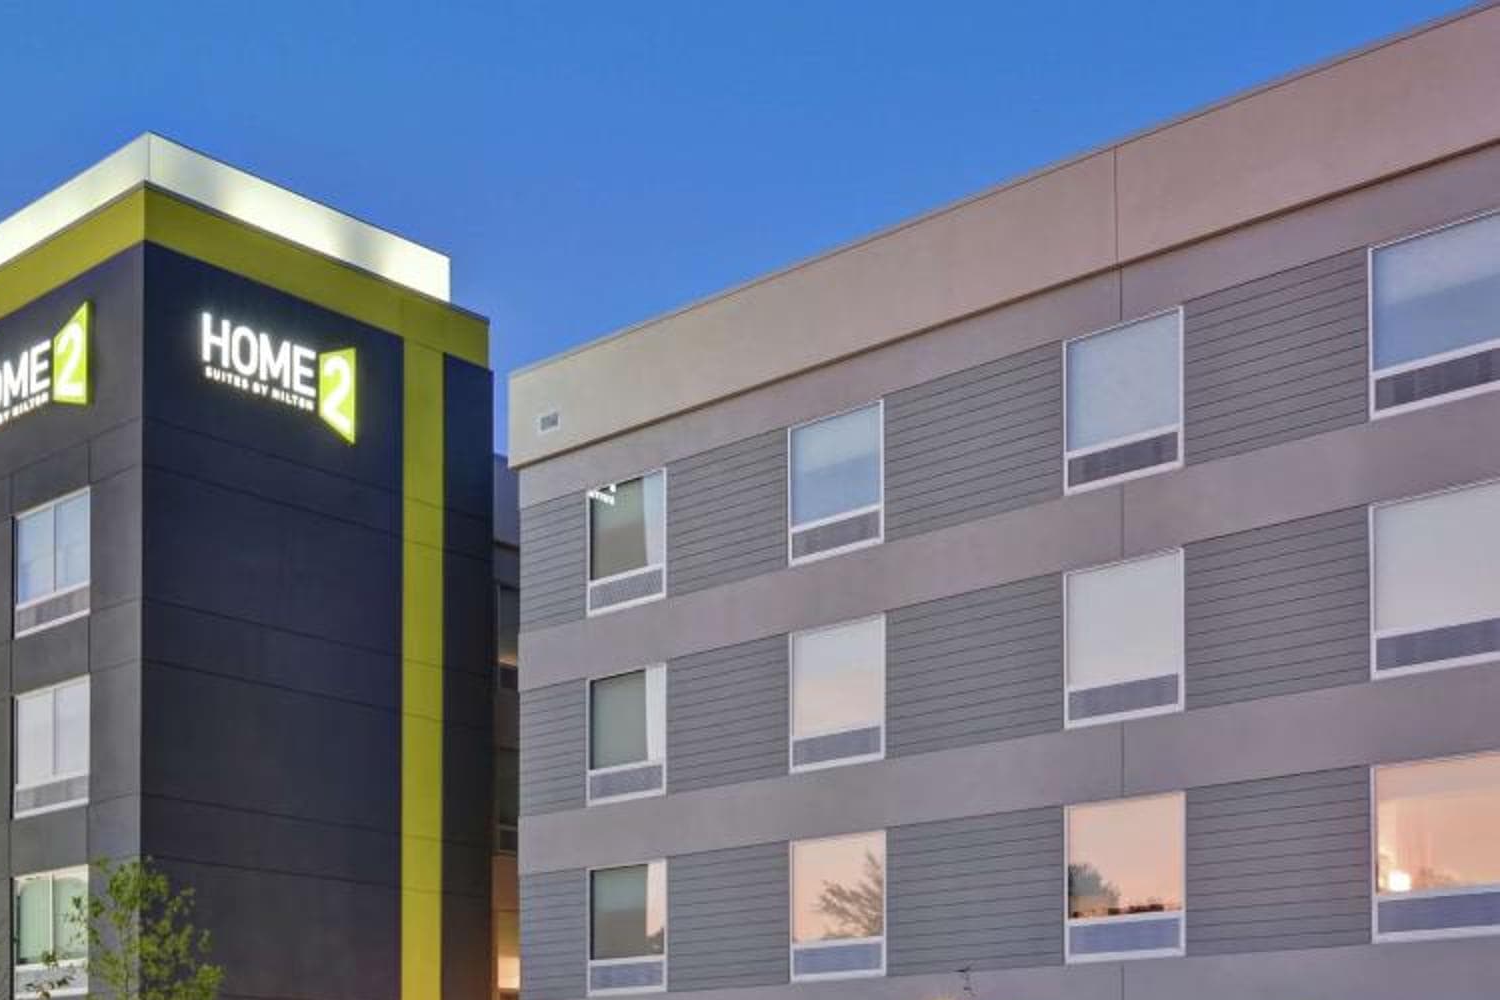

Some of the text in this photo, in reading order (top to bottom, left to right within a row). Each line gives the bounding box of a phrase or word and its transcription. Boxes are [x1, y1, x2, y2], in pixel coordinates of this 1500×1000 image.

[55, 321, 86, 397] 2
[201, 312, 354, 432] HOME 2
[204, 366, 249, 390] SUITES
[252, 381, 269, 396] BY
